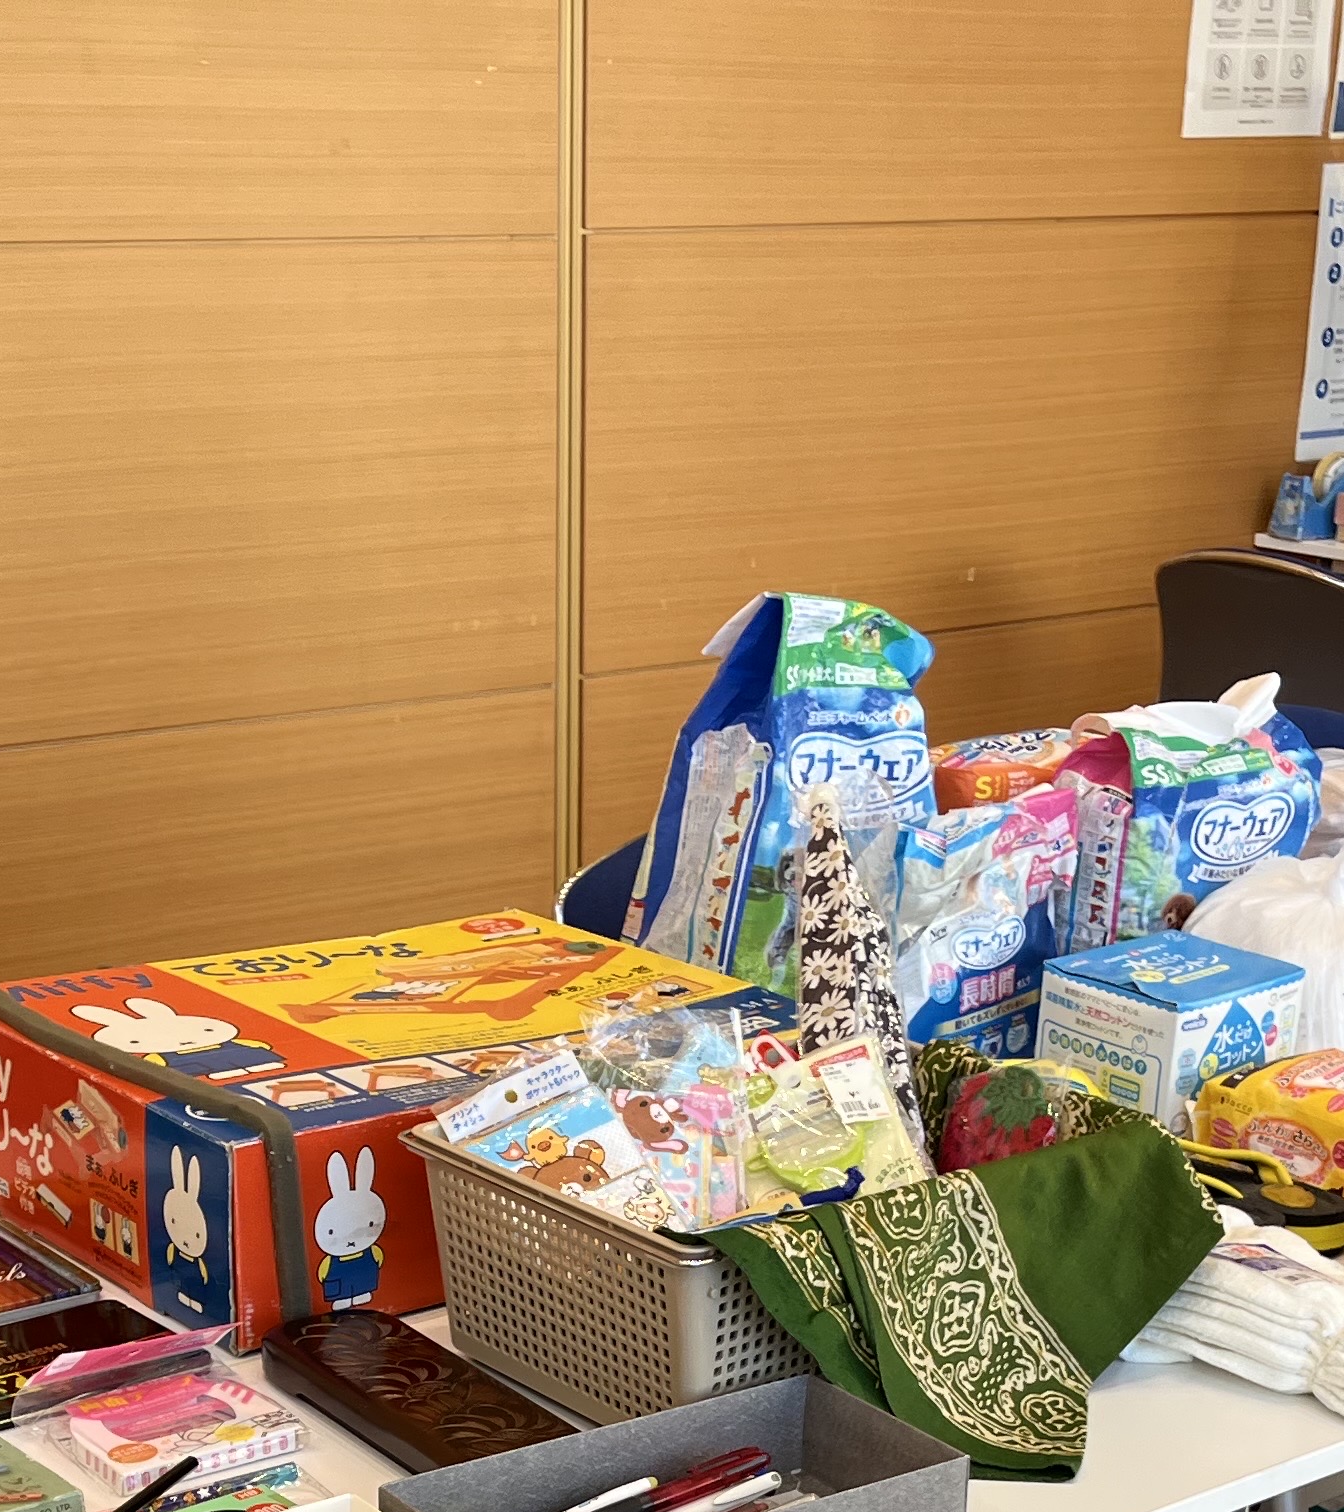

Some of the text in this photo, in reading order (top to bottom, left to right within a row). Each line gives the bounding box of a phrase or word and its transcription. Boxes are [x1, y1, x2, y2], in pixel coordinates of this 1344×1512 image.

[795, 747, 925, 785] マナーウェア
[975, 775, 993, 800] S
[1204, 807, 1286, 846] マナーウェア
[960, 925, 1022, 960] マナーウェア
[5, 968, 154, 1004] Miffy
[959, 964, 1017, 1014] 長時間
[1217, 1040, 1264, 1071] コットン
[525, 1062, 571, 1087] キャラクター
[449, 1104, 482, 1124] プリント
